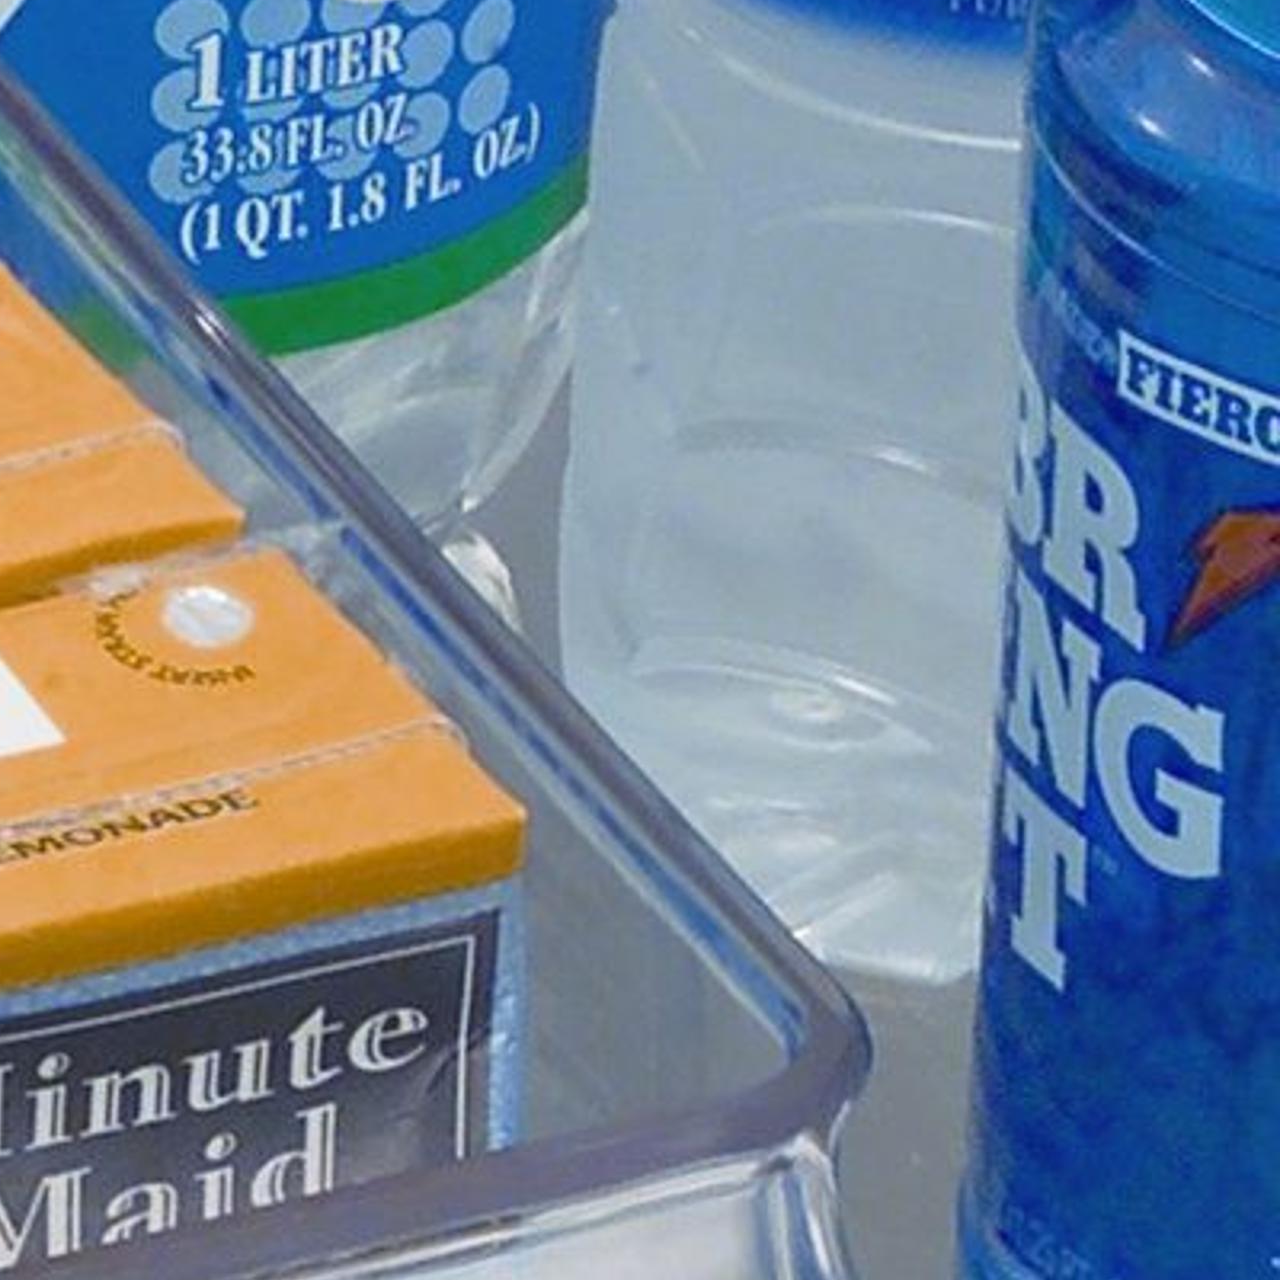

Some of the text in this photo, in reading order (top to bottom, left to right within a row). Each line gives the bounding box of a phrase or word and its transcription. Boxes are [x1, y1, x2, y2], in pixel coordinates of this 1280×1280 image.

[188, 22, 405, 111] 1 LITER
[181, 121, 274, 185] 33.8
[180, 200, 222, 266] (1
[235, 188, 310, 261] QT.
[328, 171, 387, 232] 1.8
[405, 152, 463, 212] FL.
